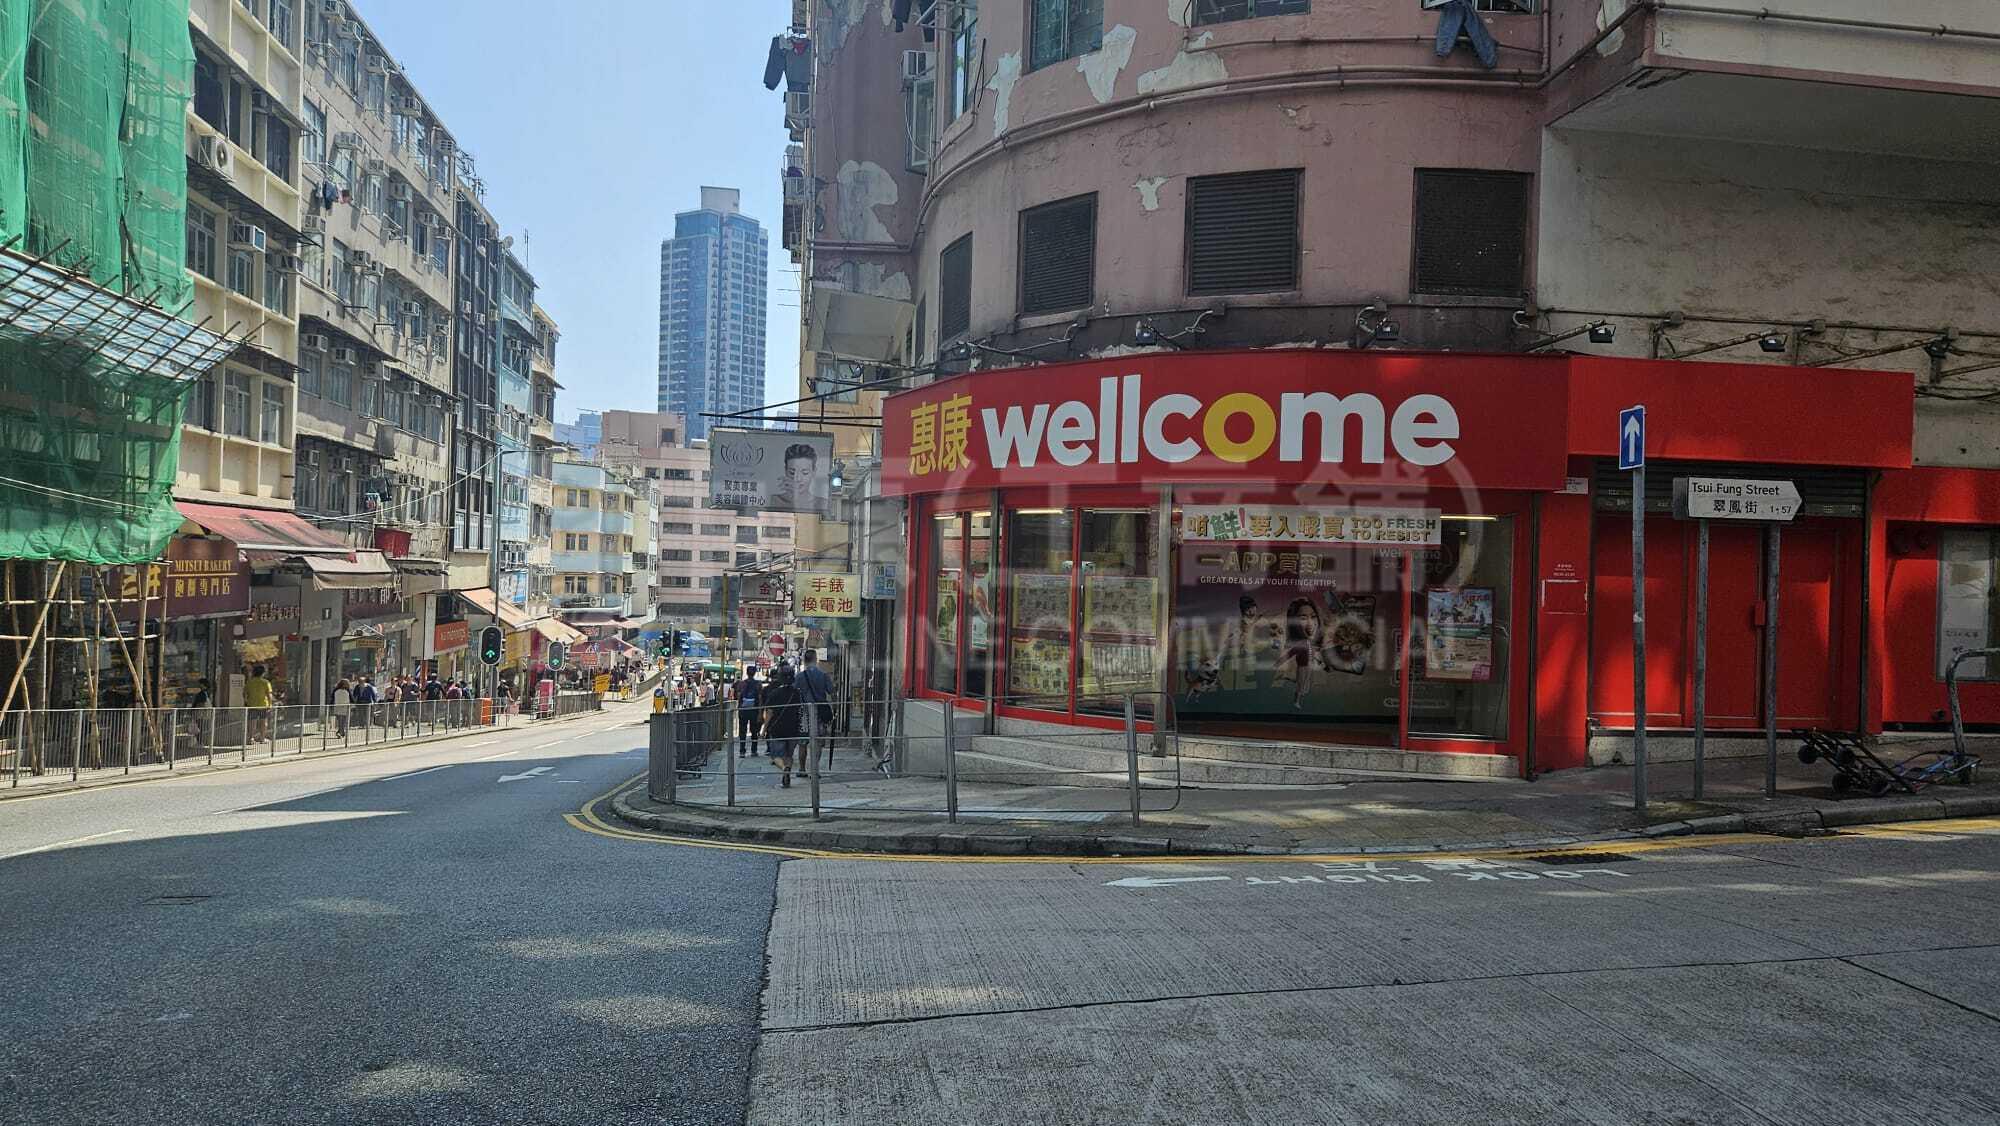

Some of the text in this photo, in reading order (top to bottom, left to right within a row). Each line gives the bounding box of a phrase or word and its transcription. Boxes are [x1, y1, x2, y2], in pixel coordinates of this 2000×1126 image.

[981, 373, 1461, 467] wellcome
[909, 393, 972, 476] 惠康
[1692, 482, 1780, 496] Tsui Fung Street
[1713, 499, 1758, 513] 翠鳳街
[1351, 516, 1437, 530] TOO FRESH
[1351, 529, 1431, 541] TO RESIST
[175, 559, 232, 572] MITSUI BAKERY
[812, 577, 845, 593] 手錶
[1200, 576, 1337, 588] GREAT DEALS AT YOUR FINGERTIPS
[801, 597, 853, 613] 換電池
[1245, 868, 1632, 885] LOOK RIGHT
